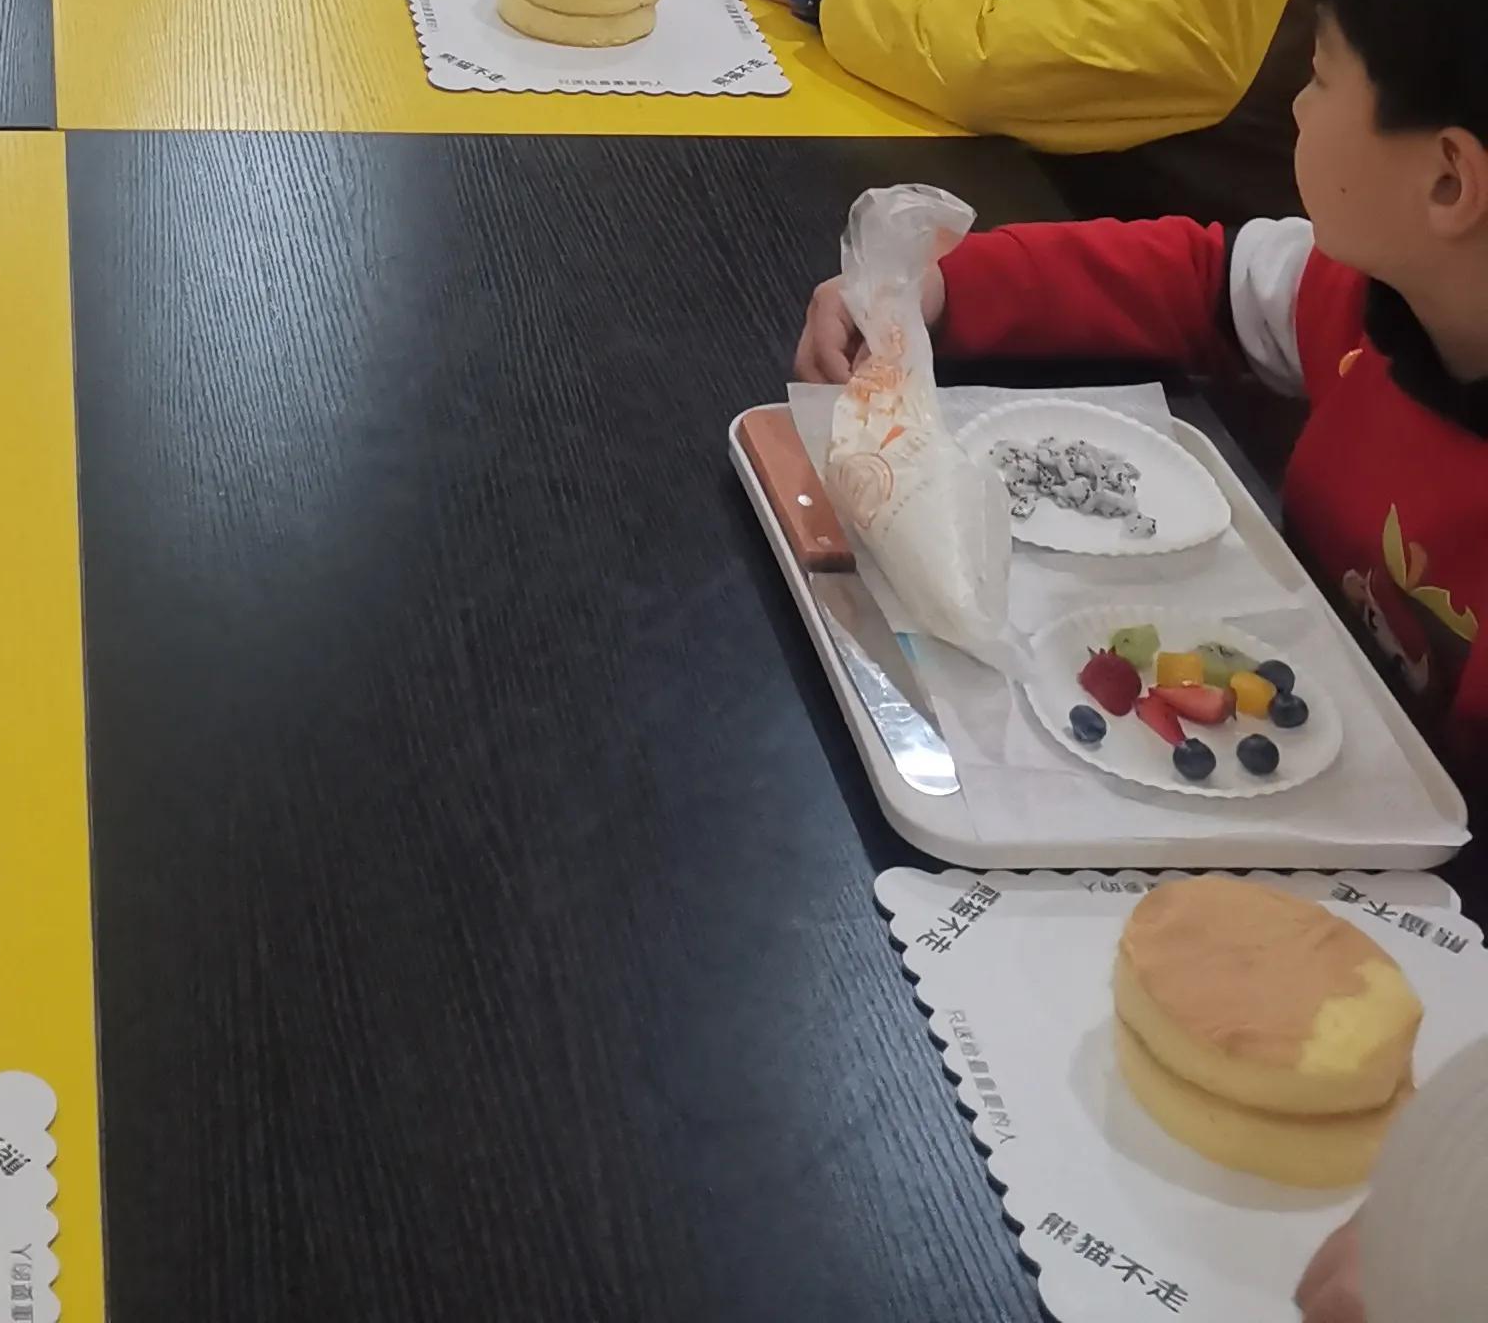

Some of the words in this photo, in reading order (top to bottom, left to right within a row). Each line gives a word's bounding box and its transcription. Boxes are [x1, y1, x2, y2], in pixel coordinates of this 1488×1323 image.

[915, 880, 1002, 955] 熊猫不走
[1036, 1211, 1190, 1313] 熊猫不走
